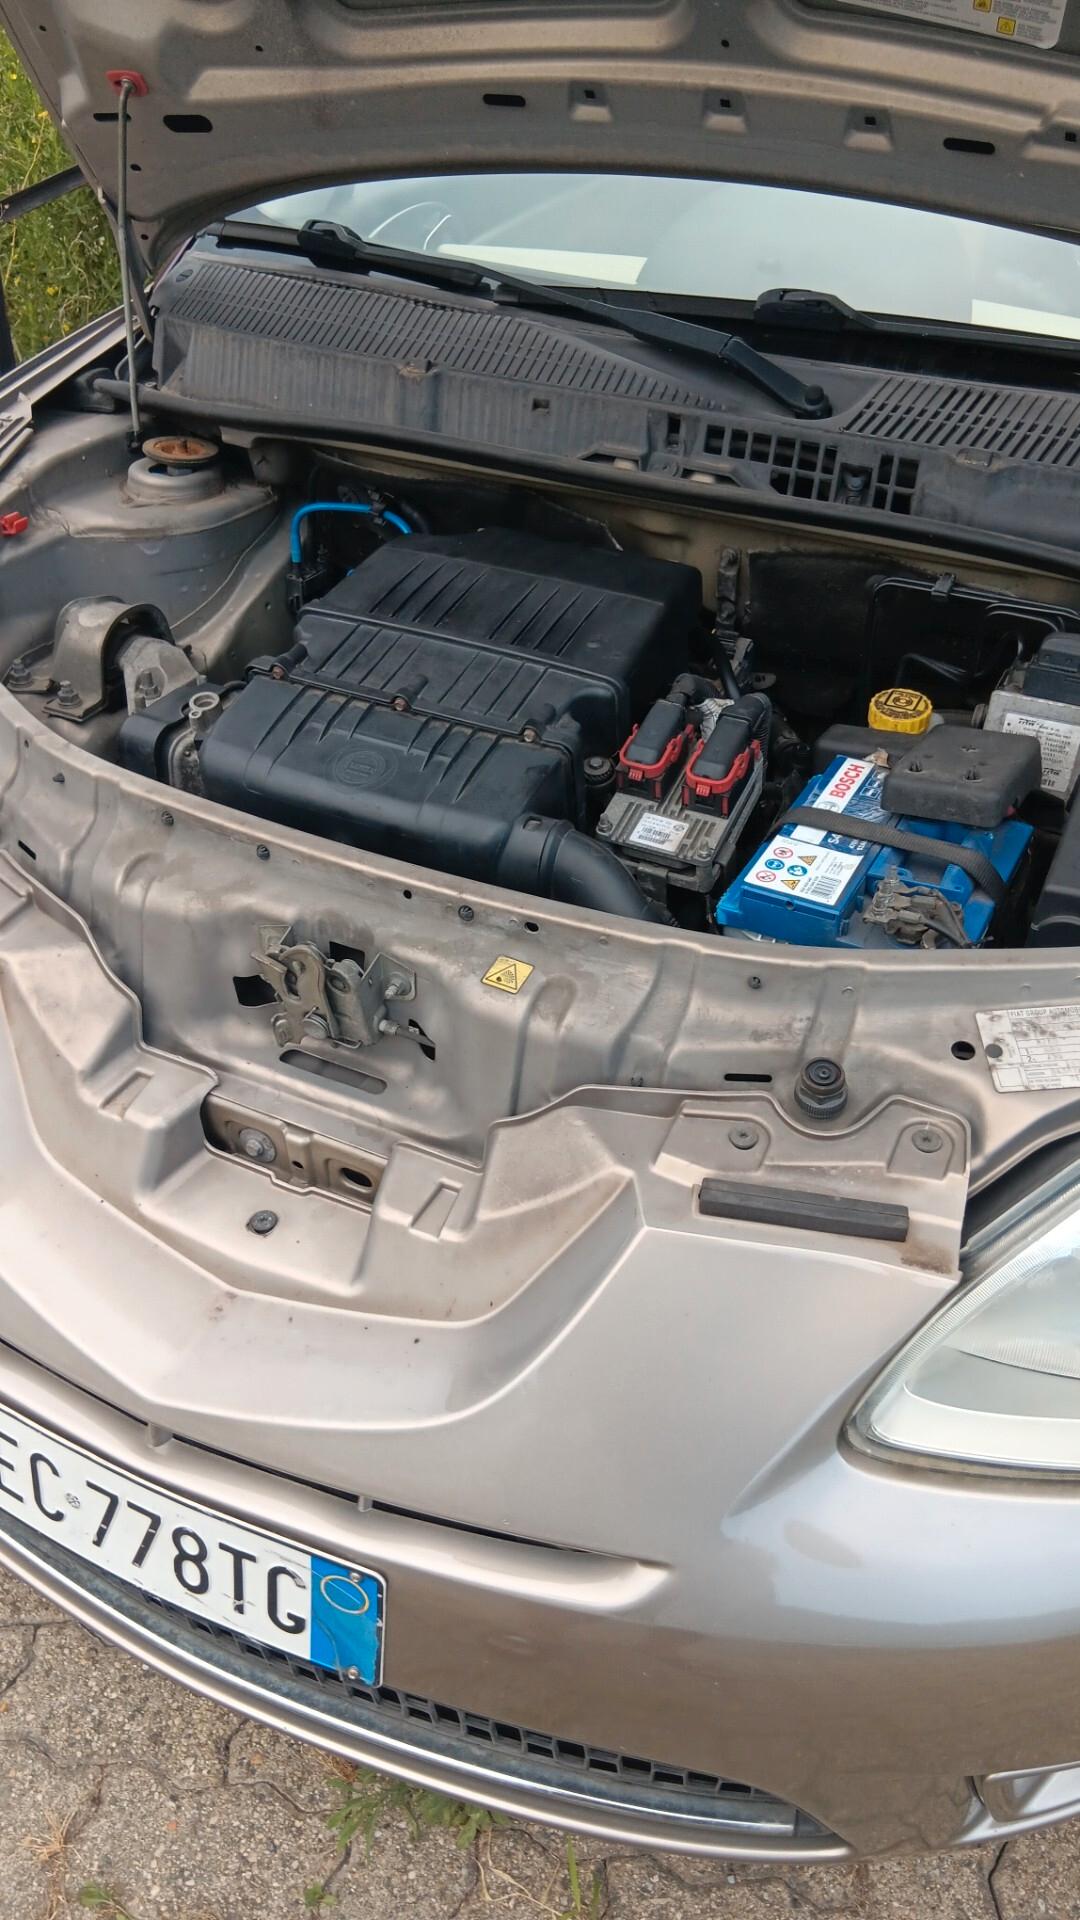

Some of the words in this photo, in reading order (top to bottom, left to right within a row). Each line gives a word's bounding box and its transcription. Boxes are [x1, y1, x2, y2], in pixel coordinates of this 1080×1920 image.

[829, 763, 866, 799] BOSCH
[0, 1431, 65, 1522] EC
[86, 1480, 307, 1634] 778TG
